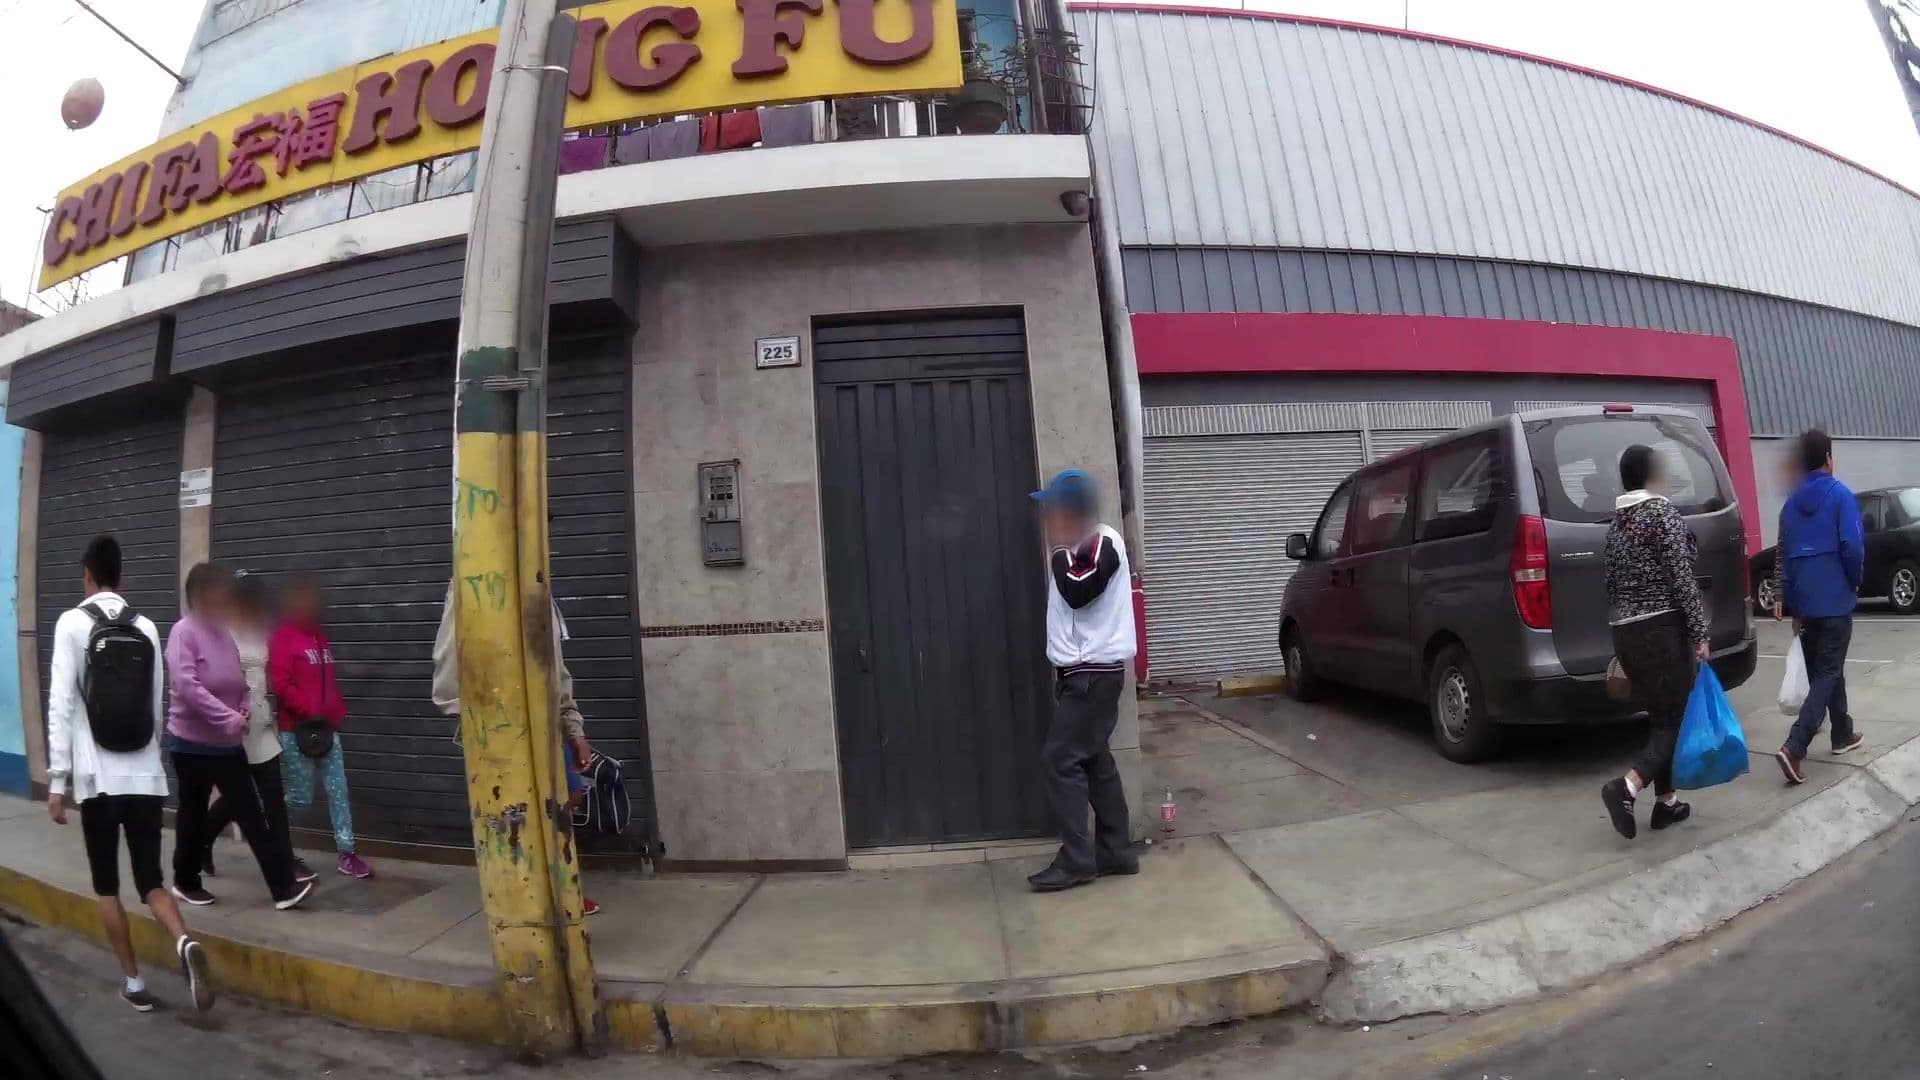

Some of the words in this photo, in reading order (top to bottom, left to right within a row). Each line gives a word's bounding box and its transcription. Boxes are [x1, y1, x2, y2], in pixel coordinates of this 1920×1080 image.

[731, 0, 935, 79] FU
[225, 92, 347, 194] 宏福
[43, 131, 222, 266] CHIFA
[763, 345, 793, 360] 225
